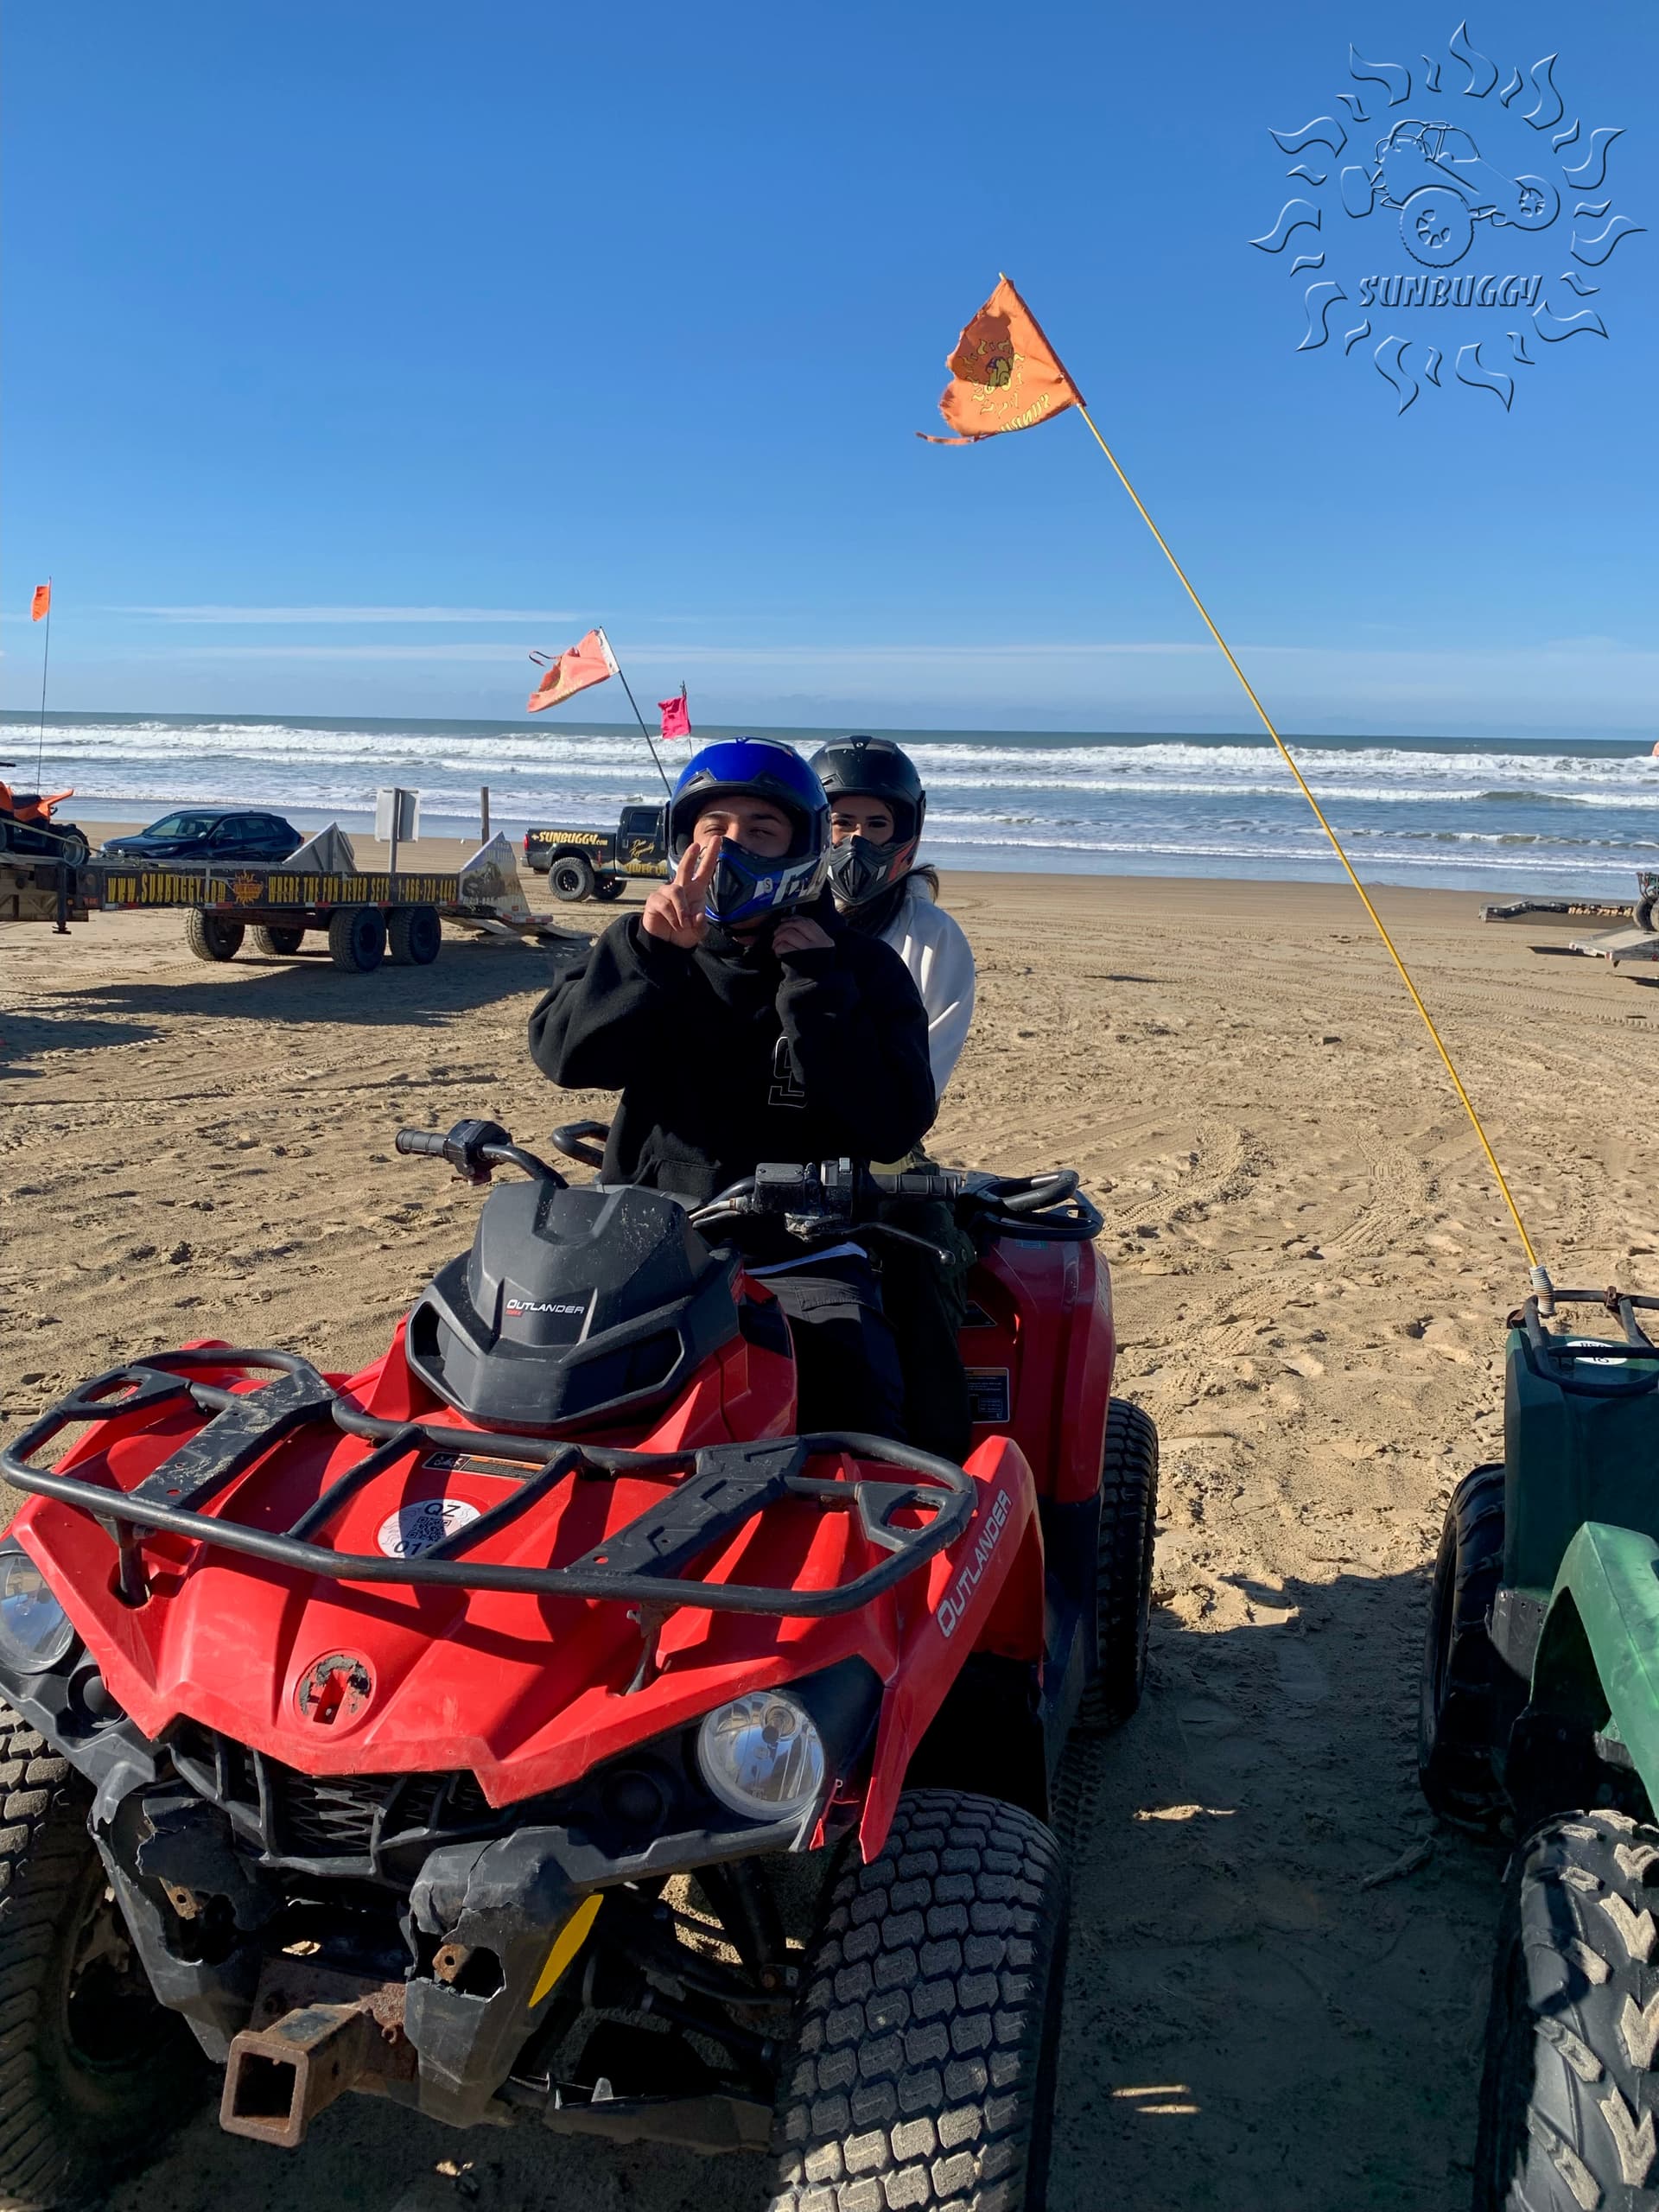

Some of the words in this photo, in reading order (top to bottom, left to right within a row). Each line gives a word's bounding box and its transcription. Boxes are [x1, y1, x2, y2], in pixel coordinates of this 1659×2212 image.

[268, 876, 299, 903] WHERE
[304, 877, 319, 902] THE
[323, 877, 339, 902] FUN
[371, 877, 390, 902] SETS
[506, 1299, 585, 1314] OUTLANDER
[424, 1503, 461, 1517] QZ
[394, 1540, 433, 1556] 01
[937, 1489, 1013, 1638] OUTLANDER
